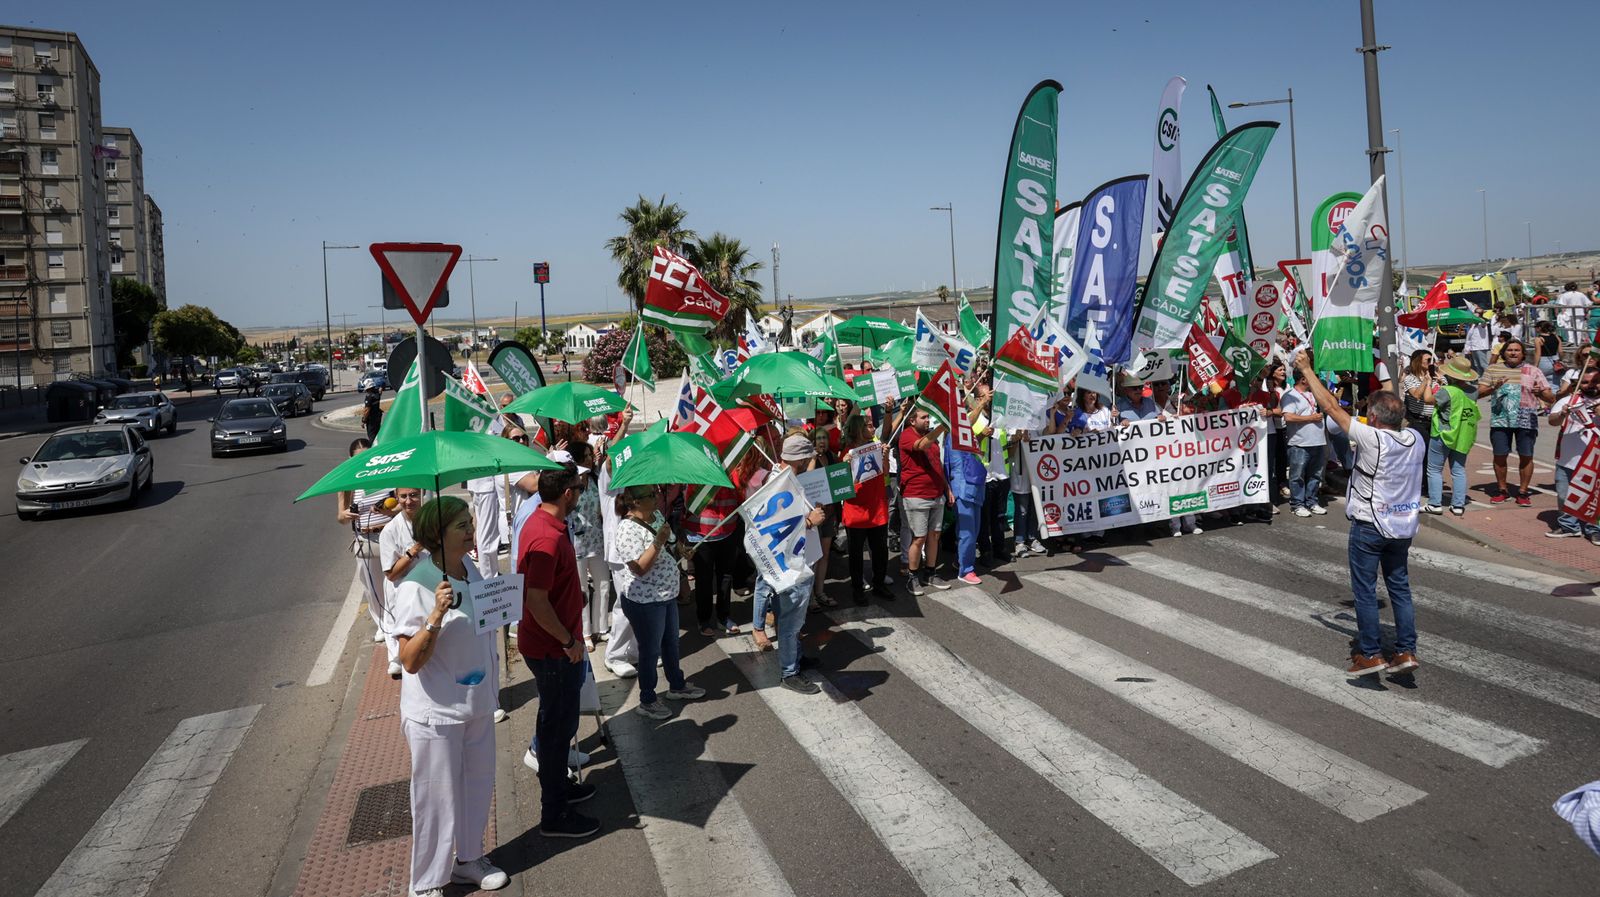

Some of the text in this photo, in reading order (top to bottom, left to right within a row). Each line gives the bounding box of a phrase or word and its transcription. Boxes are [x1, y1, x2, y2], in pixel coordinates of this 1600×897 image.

[1019, 151, 1052, 172] SATSE
[1214, 166, 1241, 181] SATSE
[1165, 182, 1232, 303] SATSE
[1007, 178, 1048, 340] SATS
[683, 295, 723, 316] Cádiz
[1151, 297, 1191, 320] CÁDIZ
[583, 397, 607, 408] SATSE
[588, 405, 613, 414] Cádiz
[1029, 409, 1258, 453] EN DEFENSA DE NUESTRA
[365, 447, 417, 467] SATSE
[1063, 436, 1232, 473] SANIDAD PÚBLICA
[355, 464, 404, 479] Cádiz
[1063, 479, 1091, 498] NO
[1095, 469, 1140, 493] MÁS
[1146, 457, 1236, 485] RECORTES
[1241, 452, 1259, 470] !!!
[1218, 482, 1239, 493] CCOO
[1247, 480, 1266, 489] CSIF
